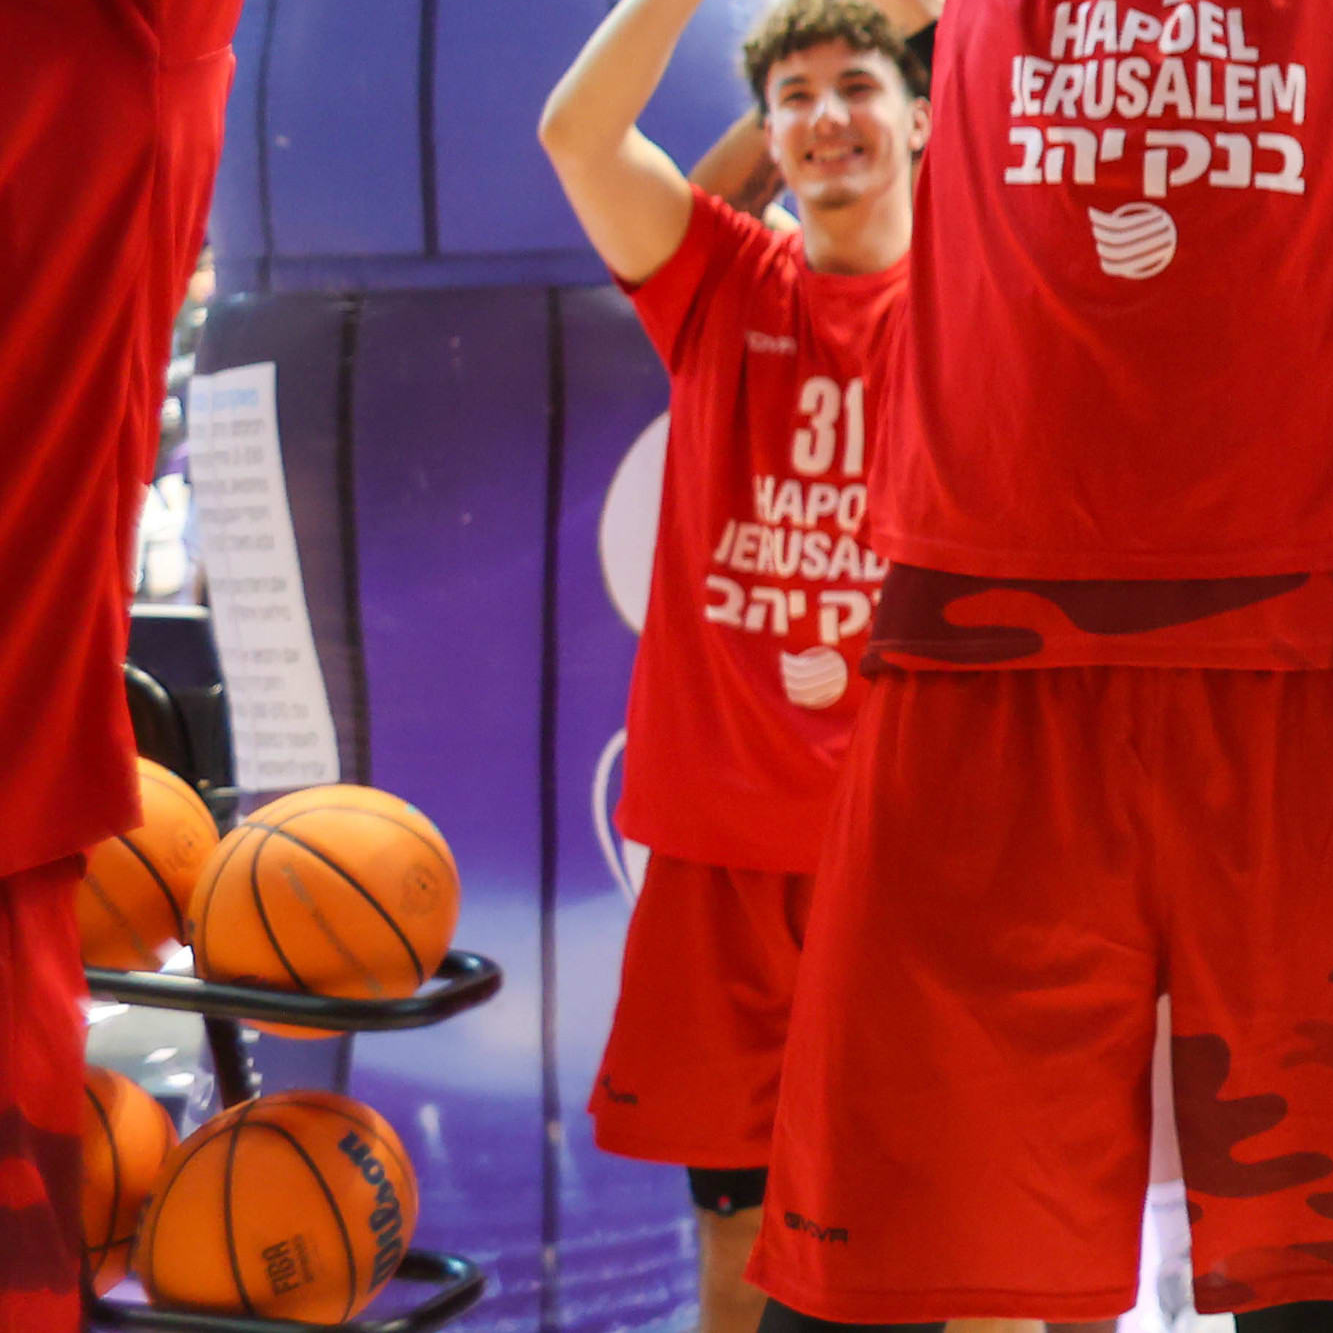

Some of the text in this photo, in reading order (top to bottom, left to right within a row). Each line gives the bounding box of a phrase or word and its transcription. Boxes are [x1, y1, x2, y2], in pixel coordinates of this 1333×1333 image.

[1011, 56, 1306, 125] JERUSALEM
[1005, 126, 1305, 198] בנק יהב
[791, 375, 865, 477] 31
[754, 474, 868, 533] HAPO
[262, 1241, 300, 1296] FIBA
